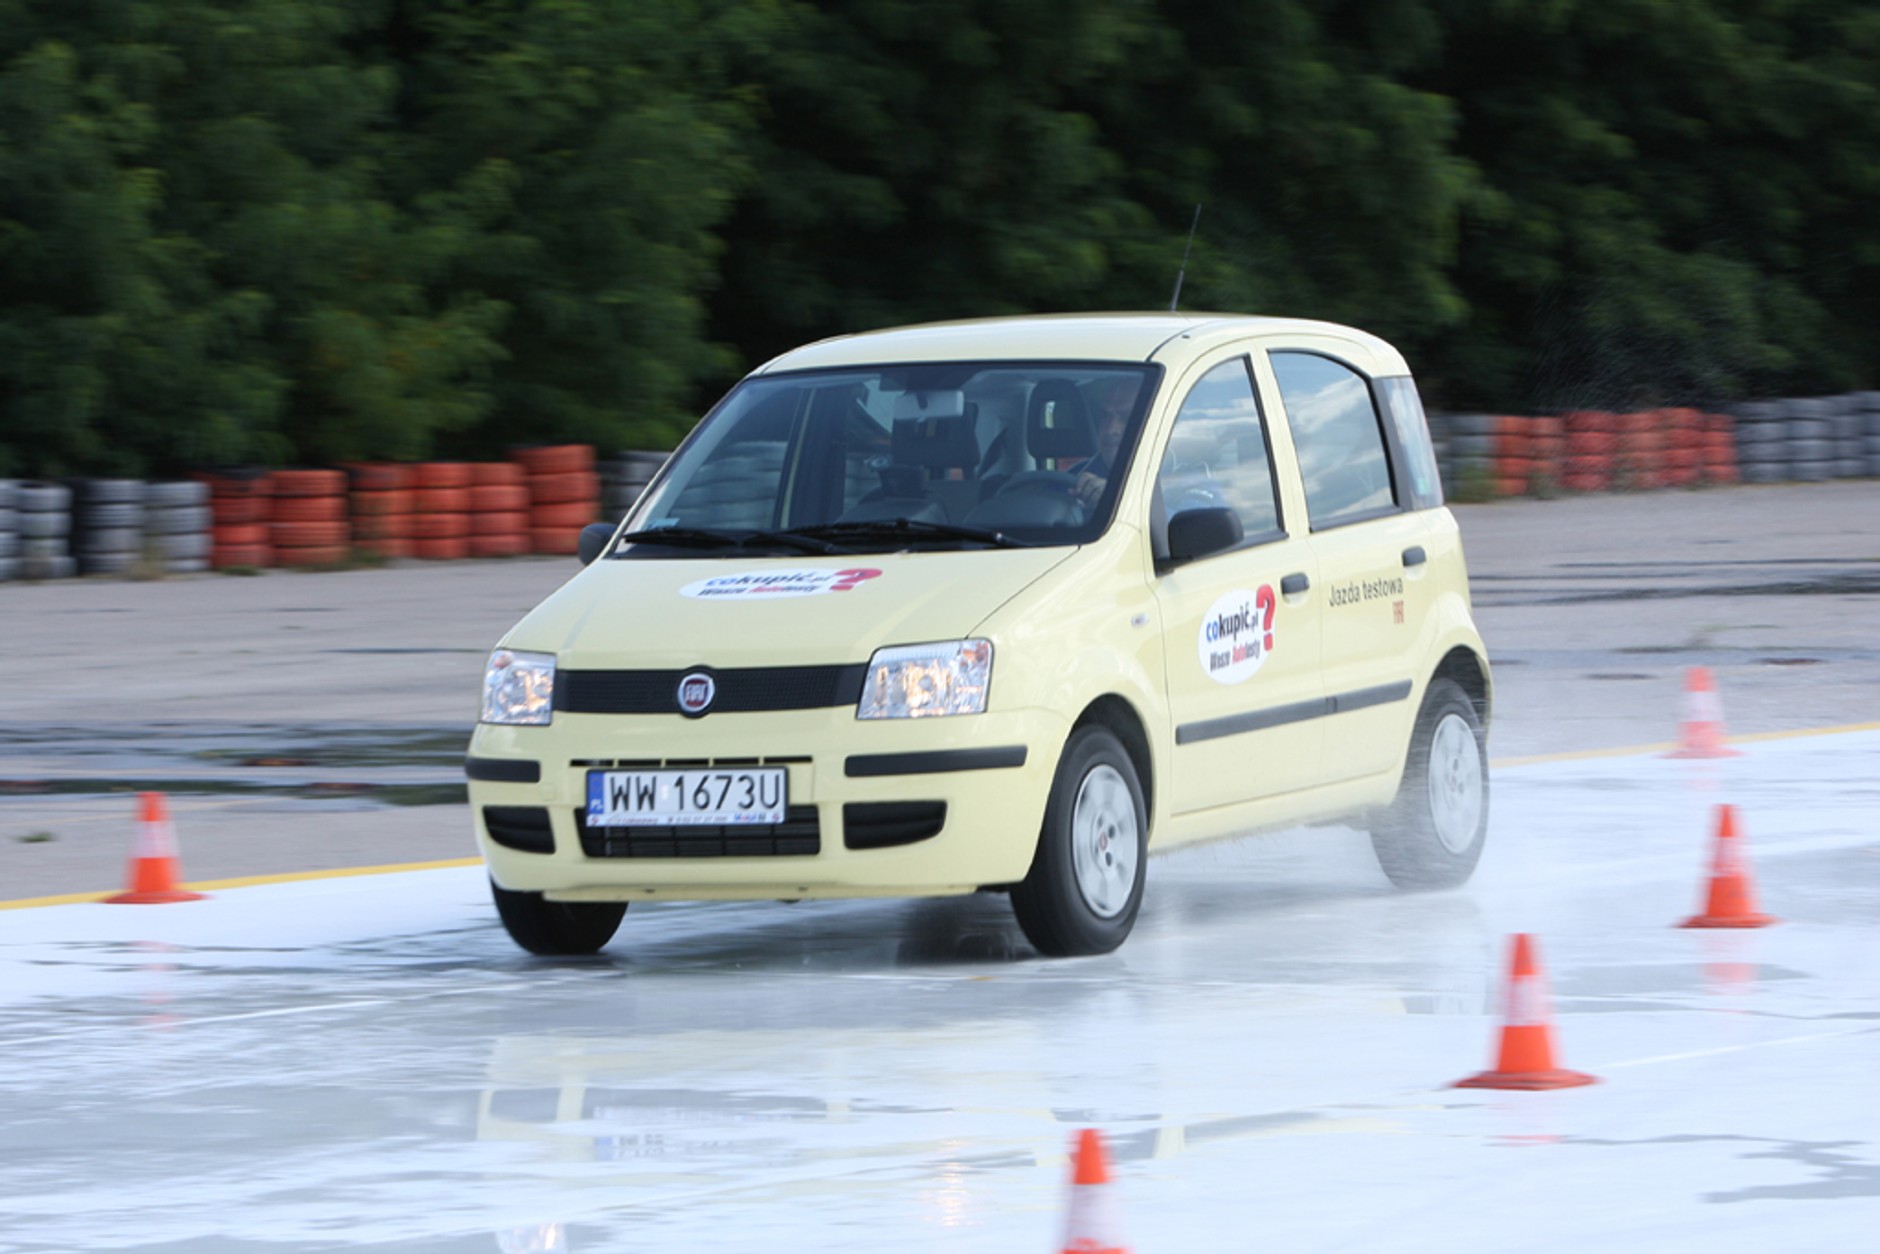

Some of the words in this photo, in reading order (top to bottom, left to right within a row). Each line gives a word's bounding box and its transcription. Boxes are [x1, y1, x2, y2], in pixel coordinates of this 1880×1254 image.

[1329, 582, 1360, 606] Jazda
[1363, 577, 1403, 600] testowa
[611, 776, 657, 811] WW
[674, 774, 779, 811] 1673U
